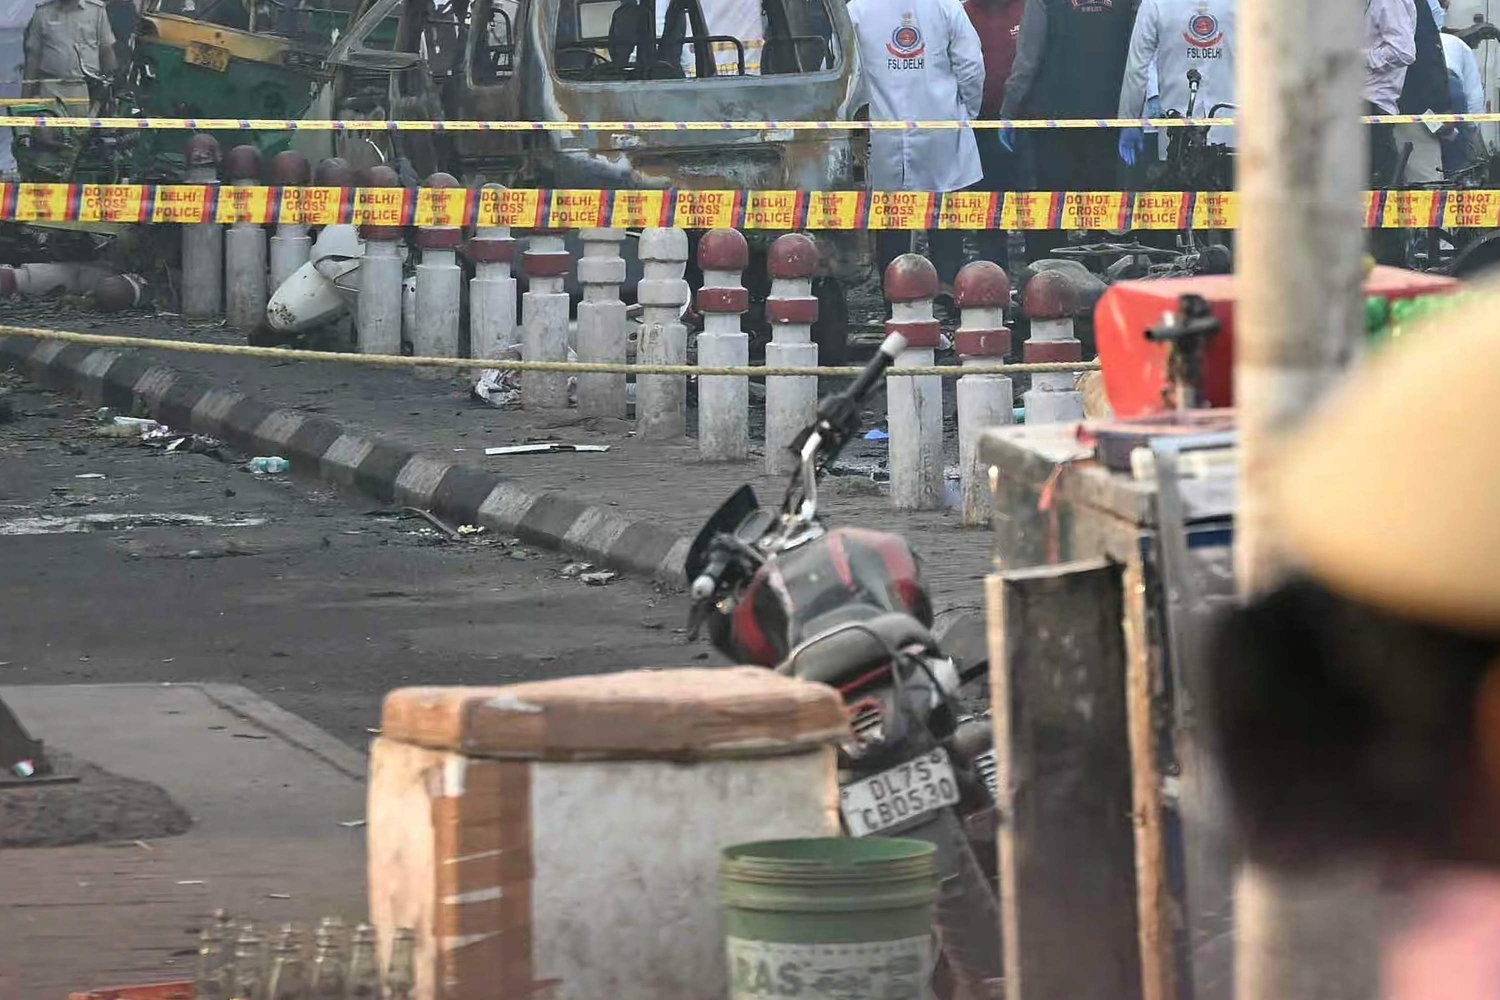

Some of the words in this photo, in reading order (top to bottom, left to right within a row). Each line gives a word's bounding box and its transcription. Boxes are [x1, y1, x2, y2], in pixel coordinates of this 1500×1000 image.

[1186, 47, 1201, 59] FSL
[1202, 47, 1223, 59] DELHI
[887, 59, 901, 70] FSL
[902, 58, 924, 70] DELHI
[85, 187, 99, 197] DO
[105, 187, 129, 197] NOT
[160, 191, 196, 201] DELHI
[284, 190, 300, 199] DO
[304, 190, 329, 199] NOT
[482, 192, 498, 201] DO
[502, 192, 526, 201] NOT
[359, 194, 395, 204] DELHI
[557, 196, 591, 205] DELHI
[679, 194, 696, 203] DO
[699, 194, 723, 203] NOT
[752, 198, 787, 207] DELHI
[873, 195, 889, 204] DO
[893, 195, 917, 204] NOT
[947, 198, 981, 208] DELHI
[1067, 195, 1083, 204] DO
[1086, 195, 1110, 204] NOT
[1449, 194, 1463, 203] DO
[1467, 194, 1491, 203] NOT
[86, 199, 127, 208] CROSS
[286, 201, 325, 211] CROSS
[484, 203, 524, 212] CROSS
[1140, 199, 1174, 208] DELHI
[156, 207, 200, 217] POLICE
[680, 205, 720, 214] CROSS
[875, 206, 914, 215] CROSS
[1068, 207, 1107, 216] CROSS
[1450, 205, 1488, 214] CROSS
[93, 210, 120, 219] LINE
[292, 213, 319, 222] LINE
[355, 210, 398, 220] POLICE
[552, 211, 595, 221] POLICE
[748, 213, 791, 223] POLICE
[941, 213, 983, 224] POLICE
[1134, 213, 1176, 224] POLICE
[490, 215, 517, 224] LINE
[686, 217, 713, 226] LINE
[881, 217, 907, 226] LINE
[1074, 218, 1100, 227] LINE
[1455, 216, 1481, 225] LINE
[868, 760, 932, 801] DL7S
